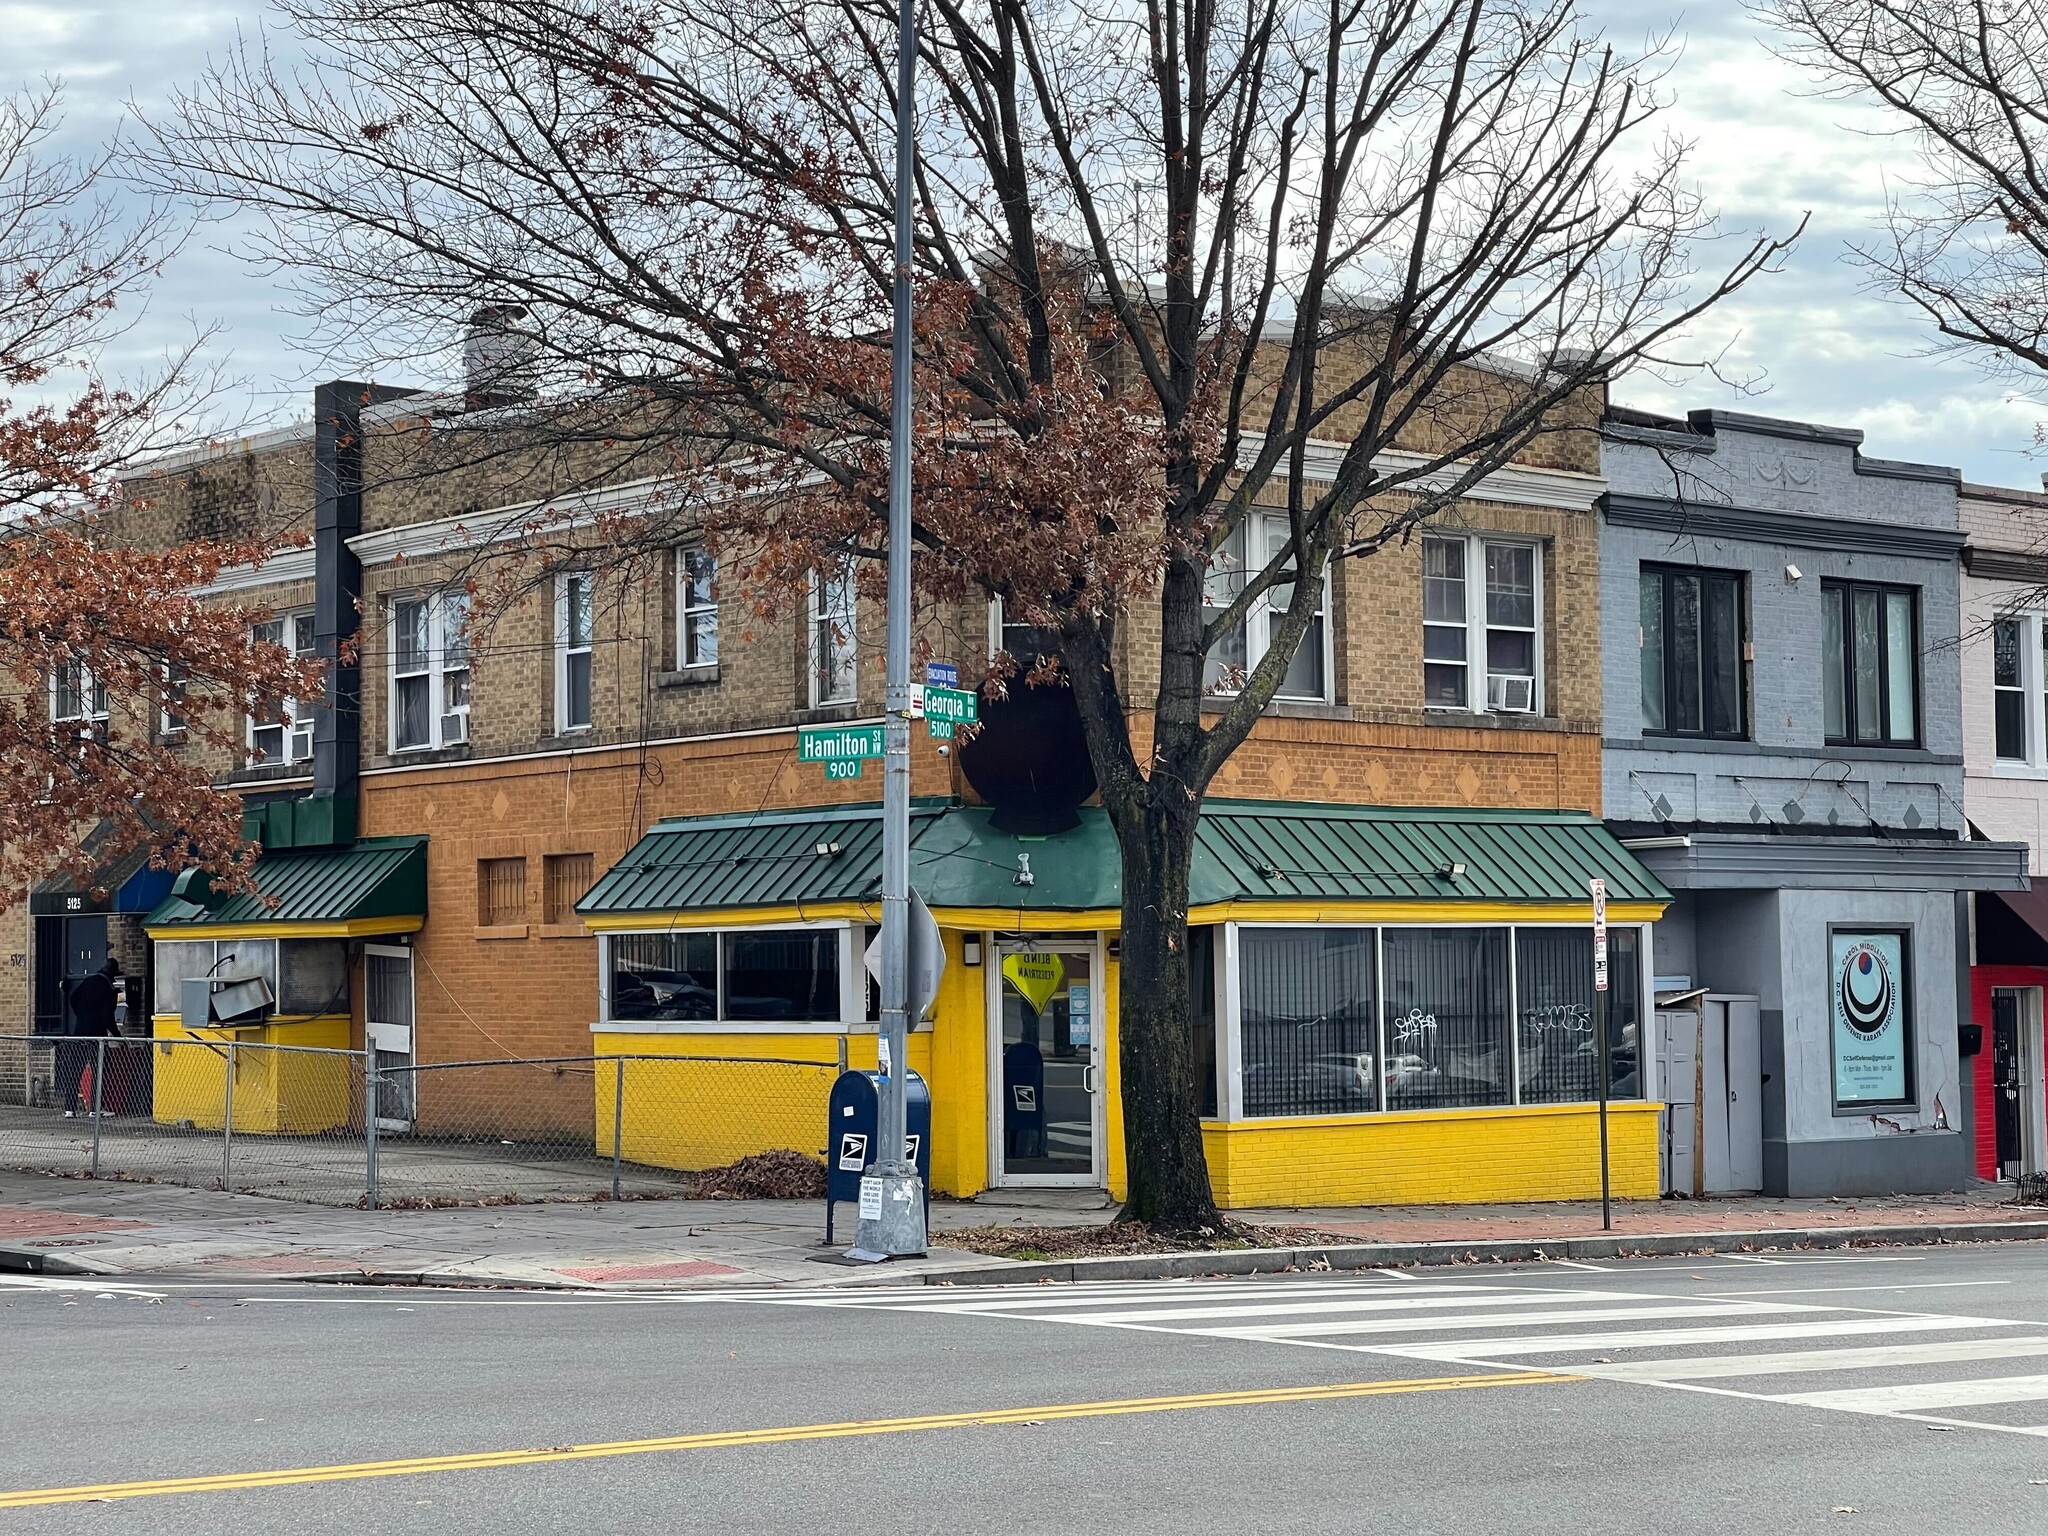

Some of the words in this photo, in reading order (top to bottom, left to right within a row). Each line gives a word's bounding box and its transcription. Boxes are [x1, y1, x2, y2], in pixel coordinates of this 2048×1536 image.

[947, 670, 957, 682] ROUTE
[925, 688, 963, 721] Georgia
[967, 706, 974, 718] NW
[872, 729, 881, 742] St
[931, 721, 951, 738] 5100
[804, 733, 868, 758] Hamilton
[872, 743, 881, 754] NW
[830, 761, 856, 778] 900
[67, 897, 82, 910] 5125
[1842, 946, 1858, 966] CAROL
[1860, 943, 1889, 966] MIDDLETON
[1843, 1019, 1862, 1040] DEFENSE
[1863, 1030, 1882, 1041] KARATE
[1882, 982, 1896, 1032] ASSOCIATION
